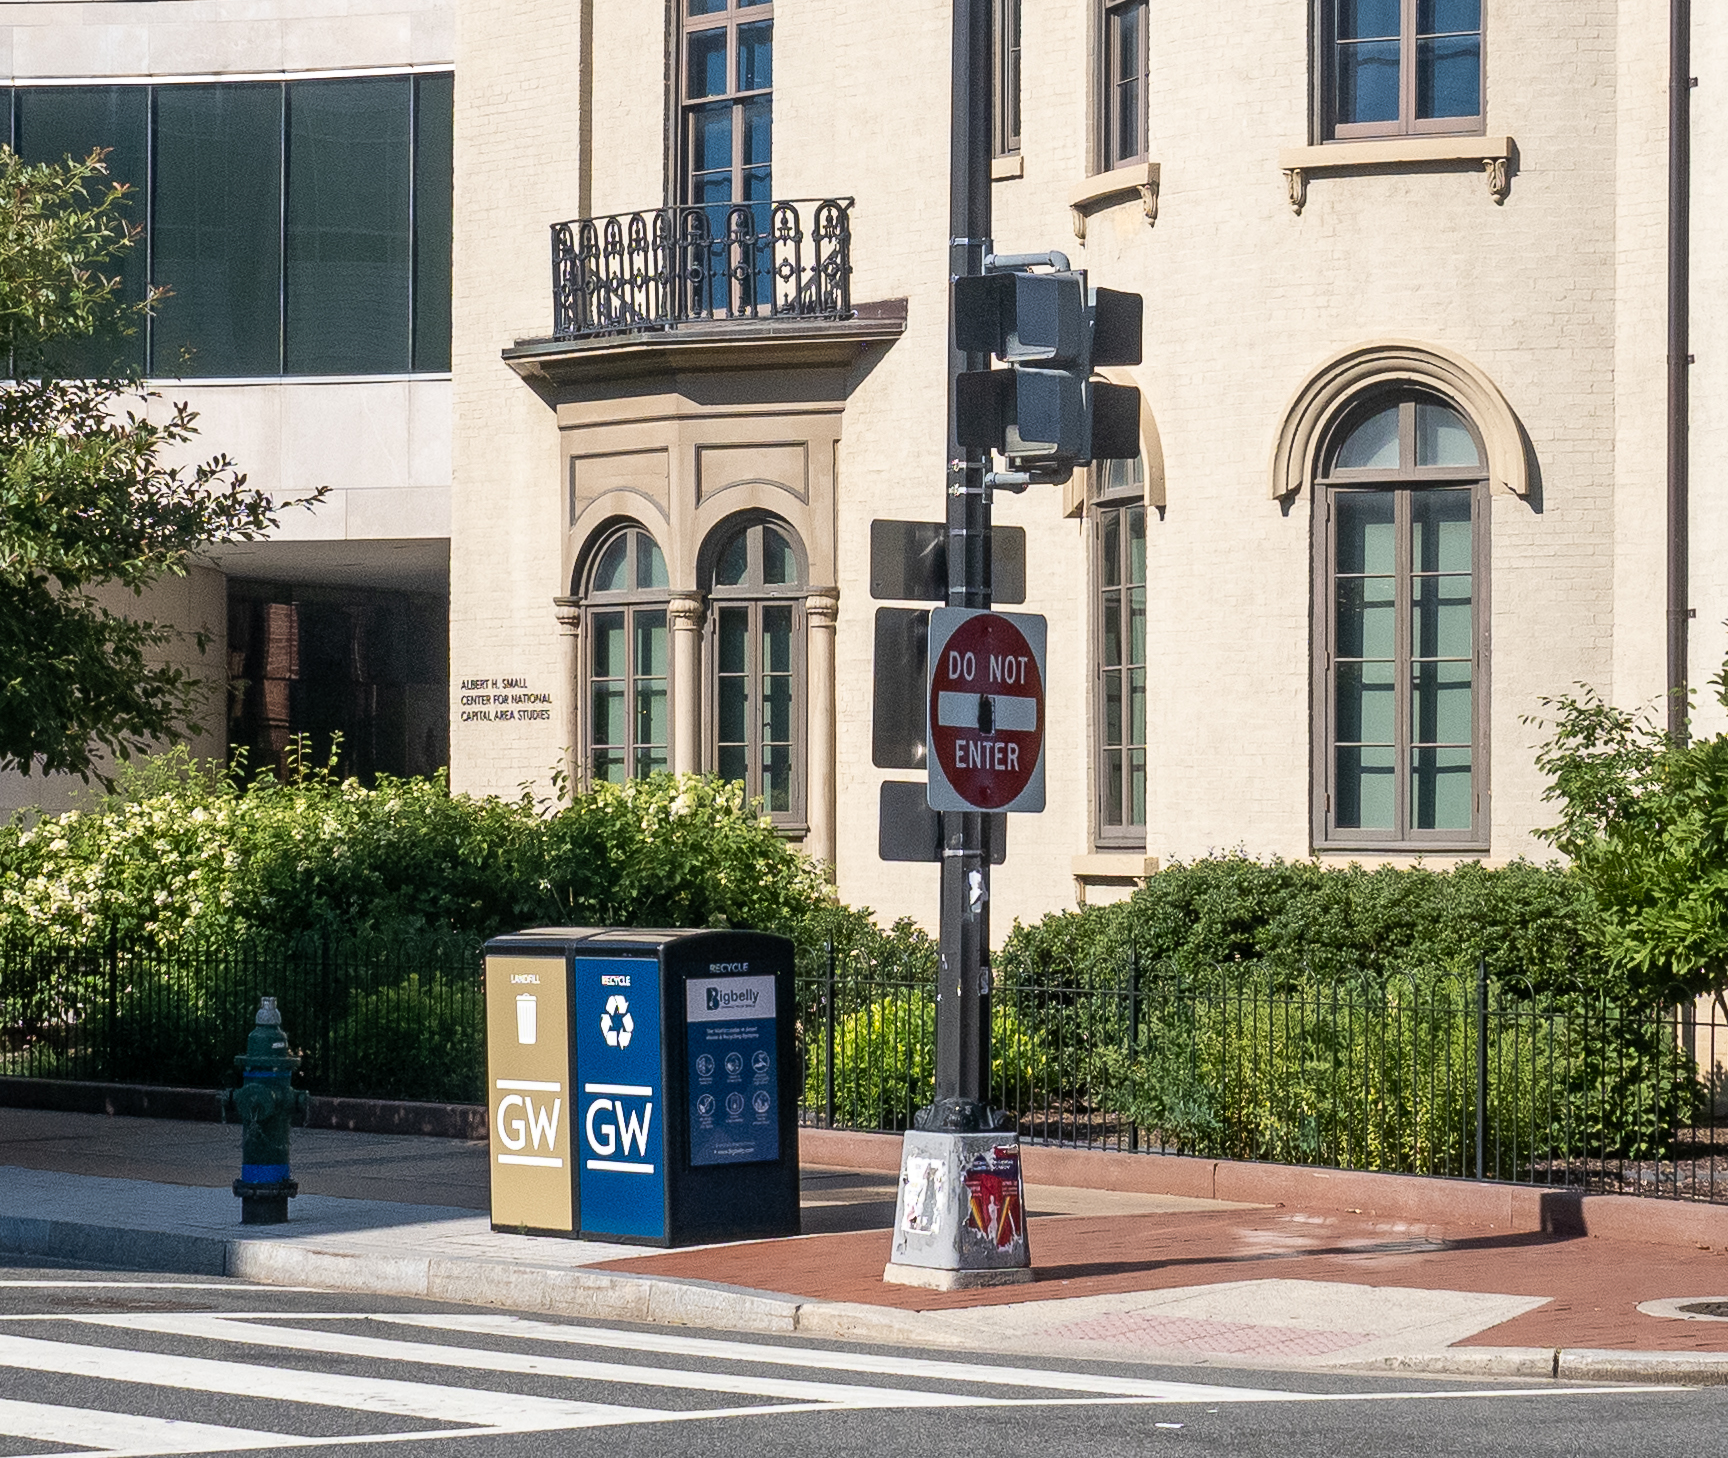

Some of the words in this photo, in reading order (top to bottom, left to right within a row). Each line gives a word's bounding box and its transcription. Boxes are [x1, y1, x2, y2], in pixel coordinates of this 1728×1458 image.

[948, 650, 976, 681] DO
[989, 653, 1029, 685] NOT
[460, 679, 490, 690] ALBERT
[491, 679, 500, 690] H.
[502, 678, 528, 689] SMALL
[460, 694, 491, 706] CENTER
[493, 694, 509, 705] FOR
[511, 693, 553, 704] NATIONAL
[460, 710, 492, 722] CAPITAL
[493, 710, 516, 721] AREA
[517, 709, 551, 721] STUDIES
[955, 739, 1020, 772] ENTER
[709, 962, 749, 973] RECYCLE
[510, 974, 540, 984] LANDFILL
[601, 975, 631, 987] RECYCLE
[705, 987, 760, 1011] Bigbelly
[496, 1094, 562, 1151] GW
[585, 1098, 653, 1157] GW
